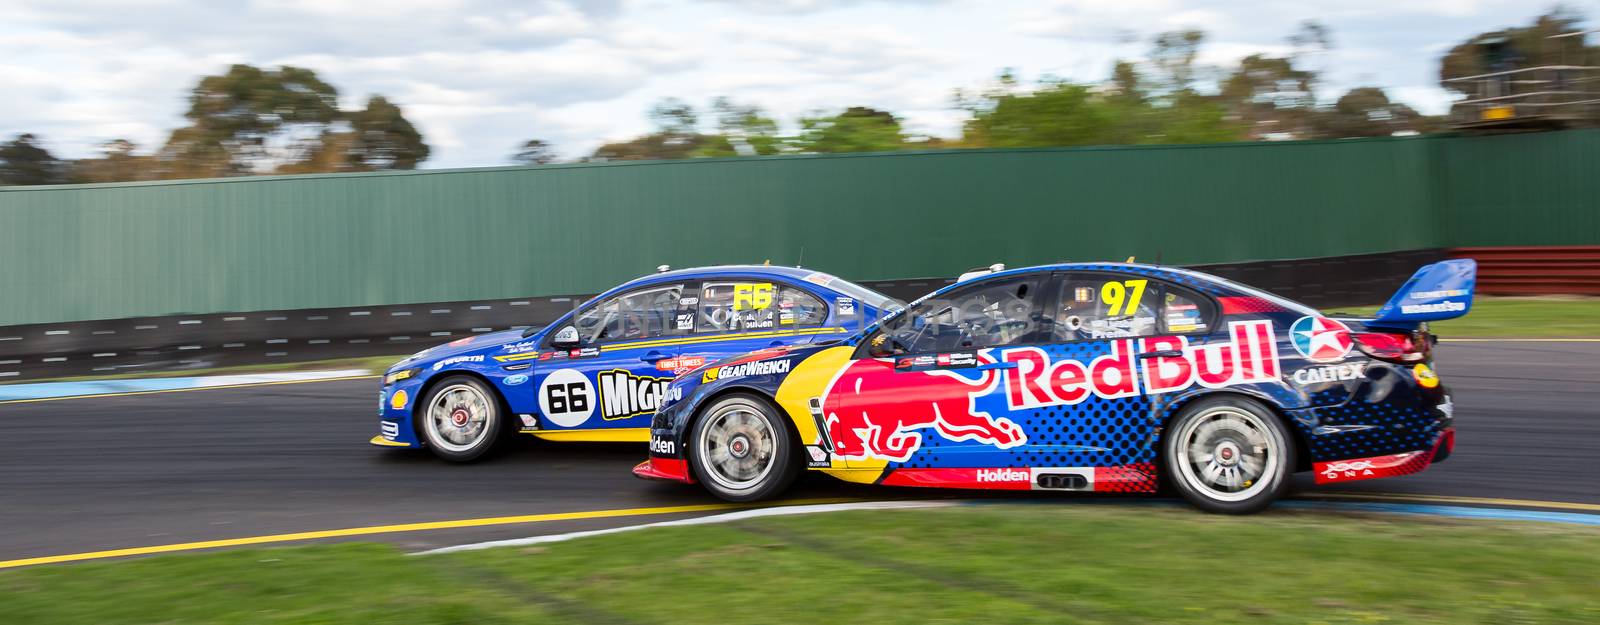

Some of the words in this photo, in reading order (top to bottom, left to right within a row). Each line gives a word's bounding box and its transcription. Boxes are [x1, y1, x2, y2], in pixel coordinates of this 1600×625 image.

[1101, 279, 1148, 316] 97
[661, 360, 679, 369] THREE
[718, 359, 791, 379] GEARWRENCH
[1002, 338, 1139, 410] Red
[1141, 320, 1280, 394] Bull
[1294, 361, 1369, 385] CALTEX
[547, 382, 589, 414] 66
[976, 468, 1030, 483] Holden
[1326, 468, 1375, 479] DNA
